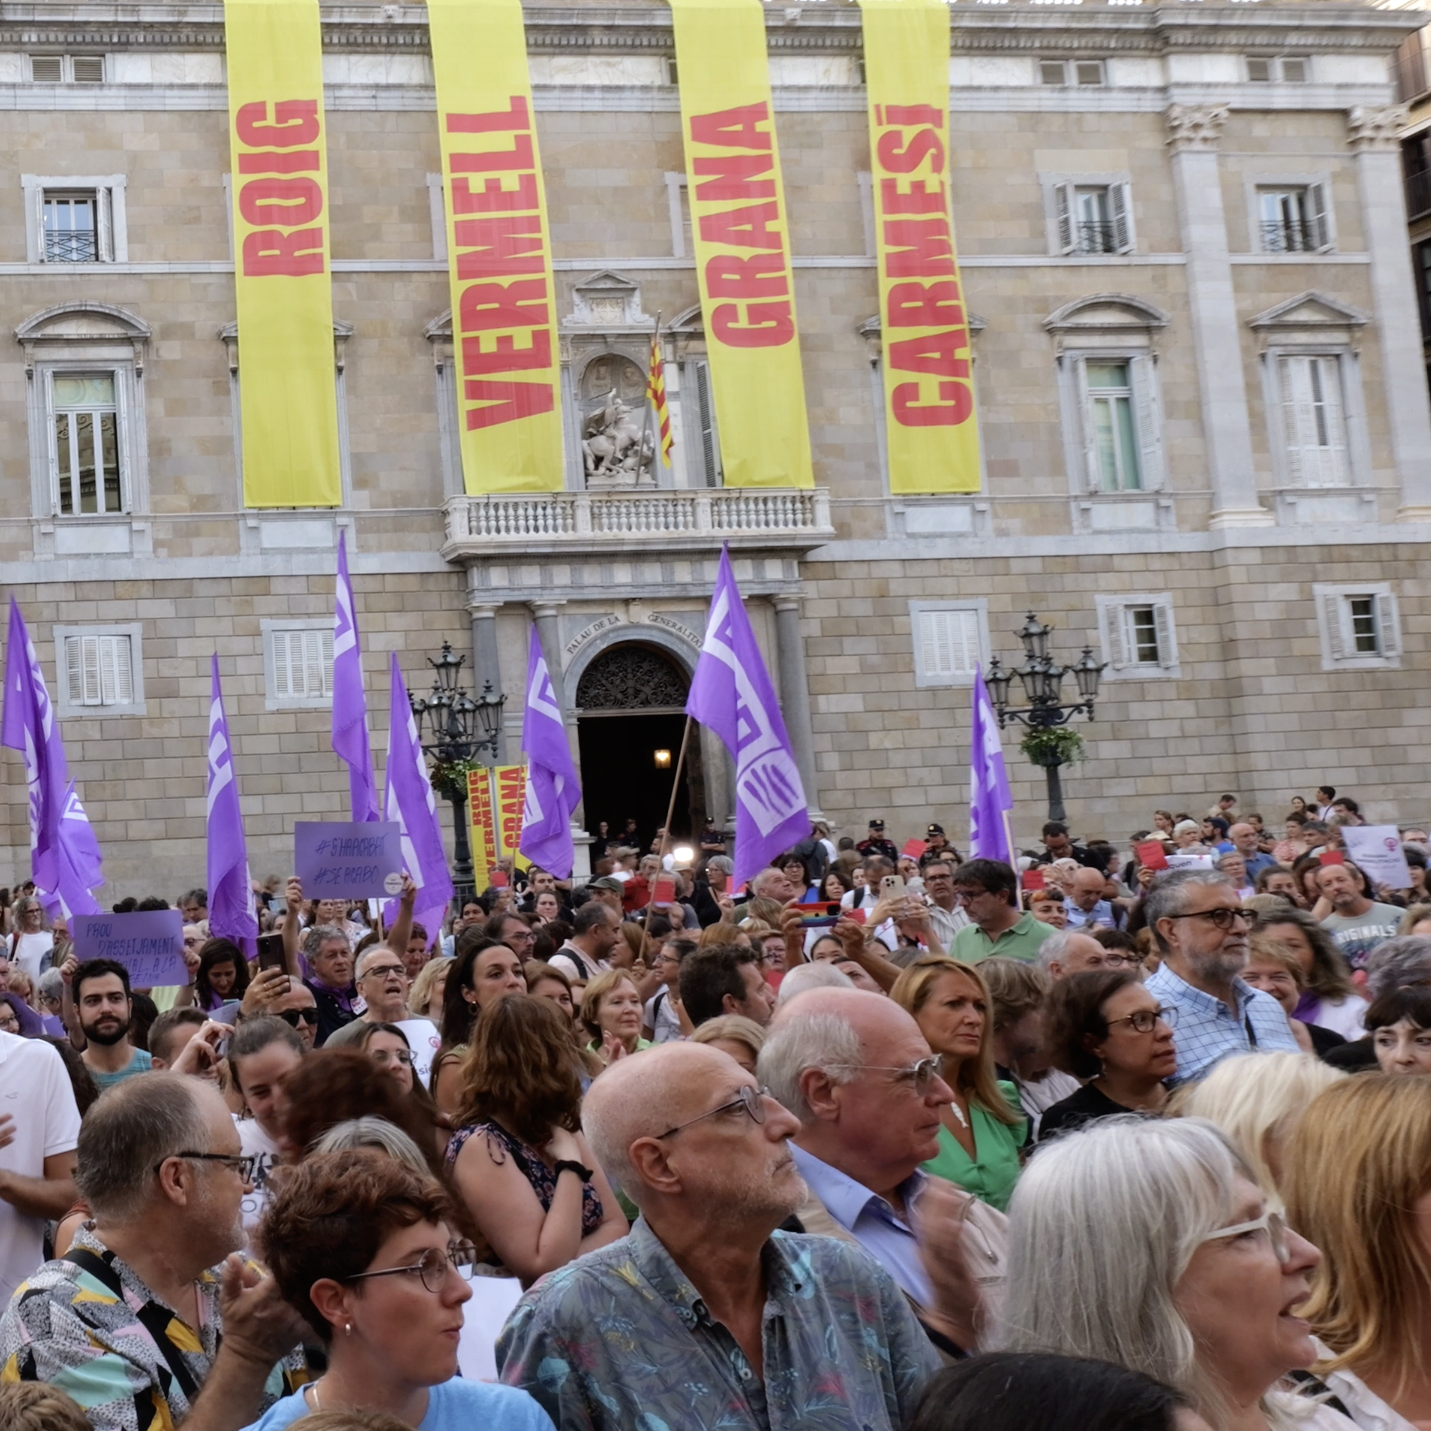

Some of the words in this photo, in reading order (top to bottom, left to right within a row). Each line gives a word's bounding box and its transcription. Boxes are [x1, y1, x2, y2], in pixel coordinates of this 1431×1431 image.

[236, 99, 325, 278] ROIG
[690, 101, 796, 349] GRANA
[445, 95, 556, 431] VERMELL
[874, 104, 973, 428] CARMESÍ
[567, 628, 592, 654] PALAU
[593, 621, 607, 632] DE
[608, 615, 621, 625] LA
[468, 771, 483, 826] ROIG
[478, 767, 497, 875] VERMELL
[86, 922, 113, 938] PROU
[1337, 925, 1397, 943] RIGINALS
